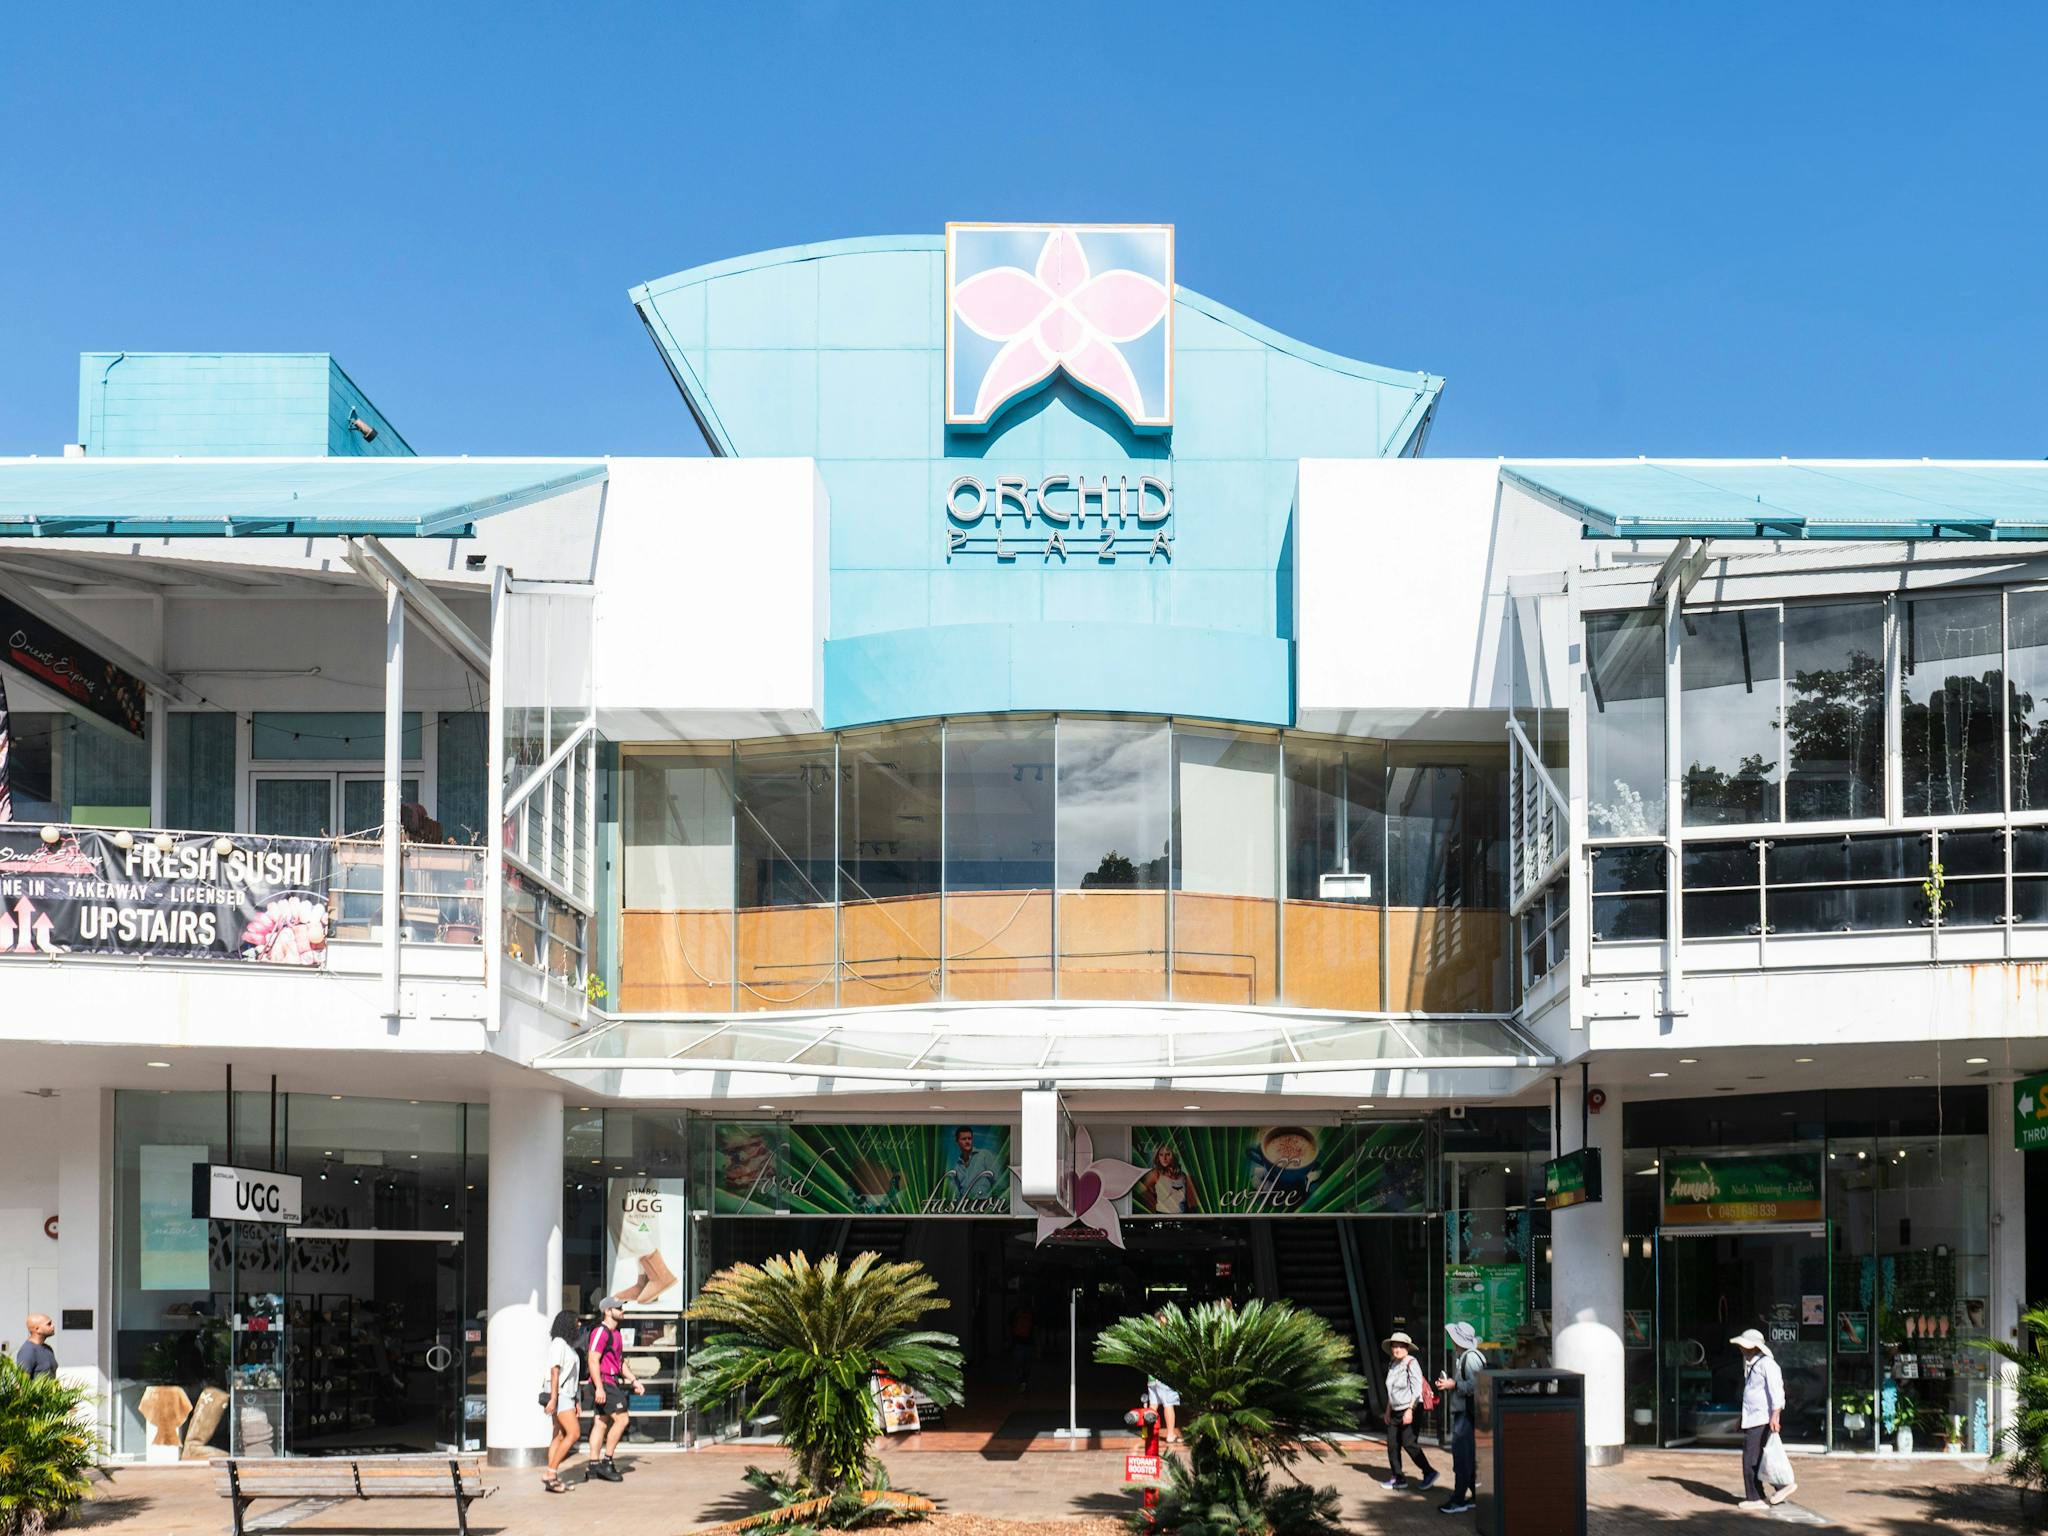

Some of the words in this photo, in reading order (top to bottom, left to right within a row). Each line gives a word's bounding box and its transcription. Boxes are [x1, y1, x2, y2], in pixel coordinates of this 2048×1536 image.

[946, 475, 1173, 522] ORCHID
[946, 529, 1173, 559] PLAZA
[8, 630, 54, 666] Orient
[125, 844, 218, 880] FRESH
[226, 849, 311, 886] SUSHI
[0, 878, 23, 896] NE
[29, 879, 45, 896] IN
[67, 880, 148, 901] TAKEAWAY
[171, 886, 247, 906] LICENSED
[79, 904, 218, 946] UPSTAIRS
[2022, 1125, 2048, 1144] THRO
[1346, 1129, 1425, 1179] jewels
[627, 1187, 660, 1198] JUMBO
[736, 1143, 836, 1215] food
[919, 1169, 1011, 1214] fashion
[1219, 1156, 1302, 1214] coffee
[236, 1180, 280, 1214] UGG
[621, 1198, 663, 1214] UGG
[1771, 1328, 1797, 1341] OPEN
[1128, 1456, 1158, 1466] HYDRANT
[1128, 1465, 1158, 1475] BOOSTER
